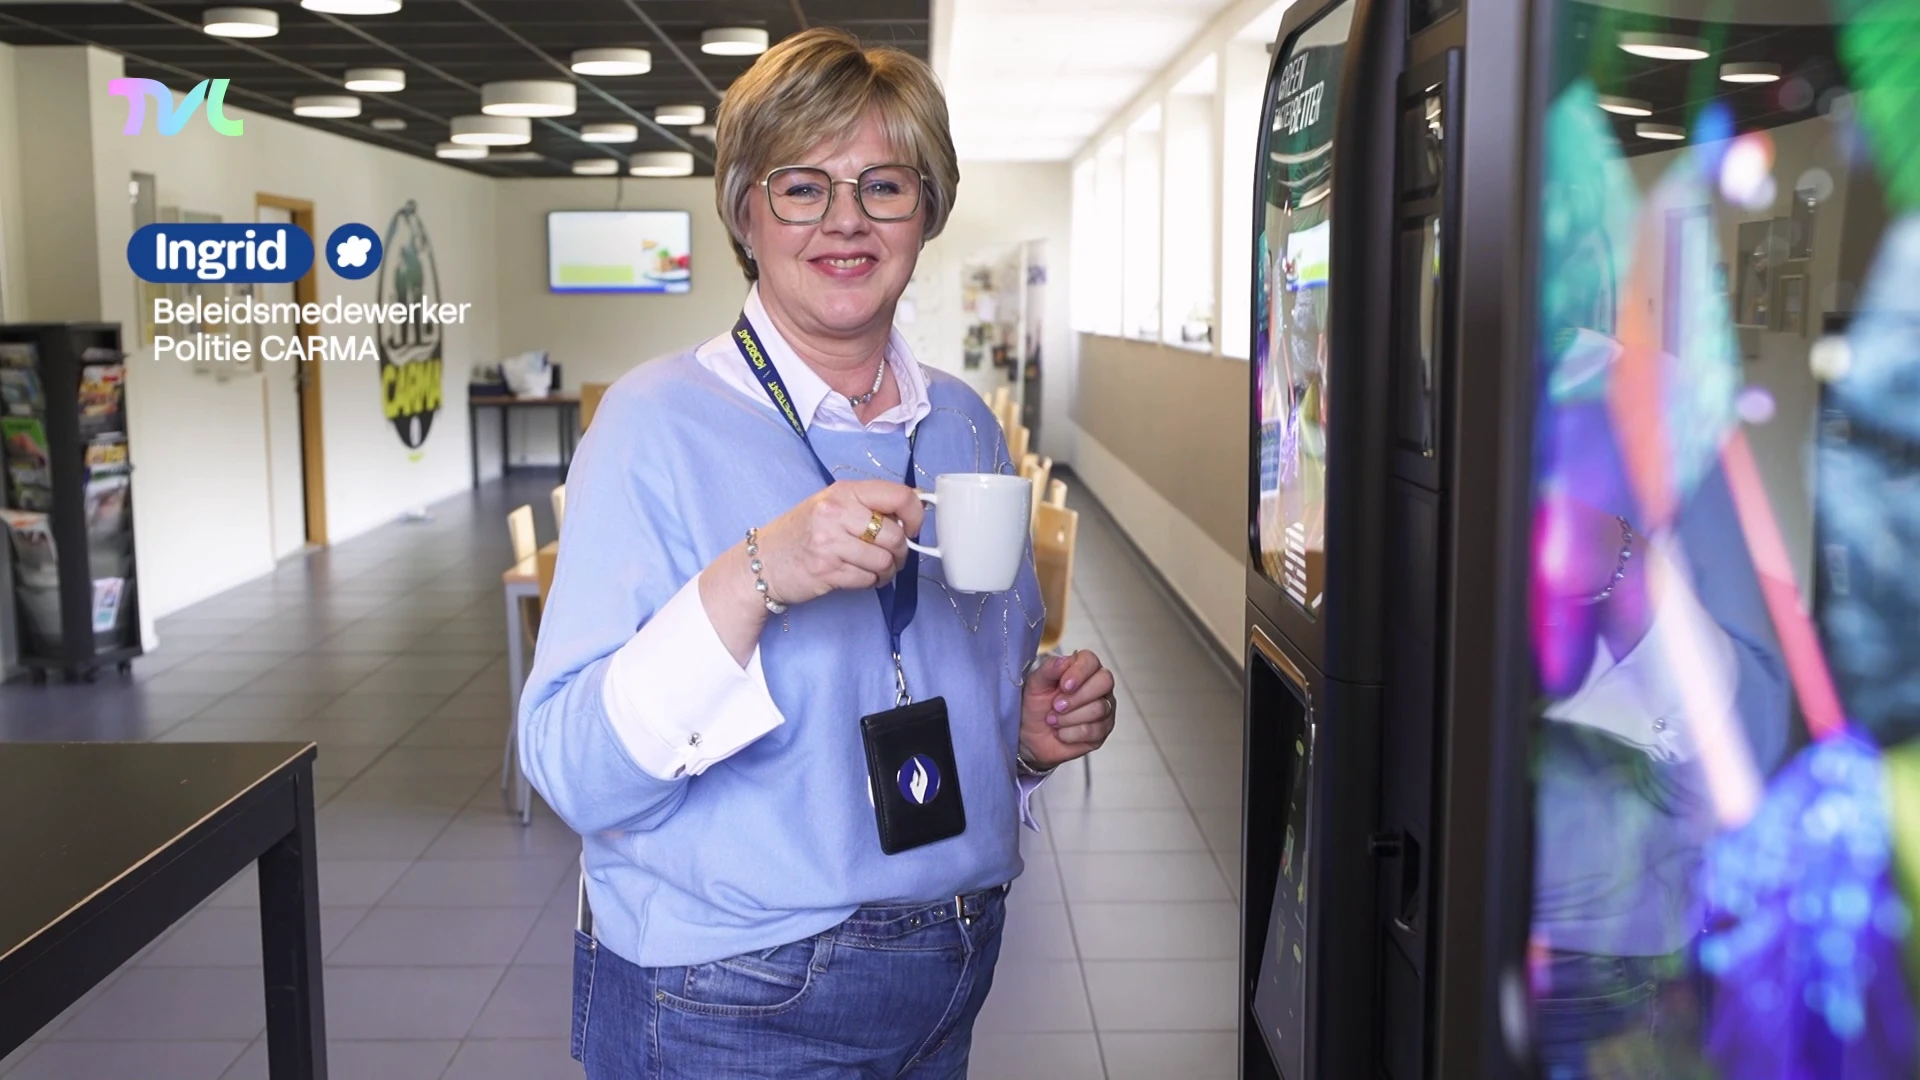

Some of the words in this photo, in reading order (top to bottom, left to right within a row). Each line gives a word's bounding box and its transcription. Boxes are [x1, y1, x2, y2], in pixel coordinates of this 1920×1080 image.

[1278, 51, 1309, 101] GREEN
[1288, 80, 1324, 135] BETTER
[380, 356, 445, 420] CARMA
